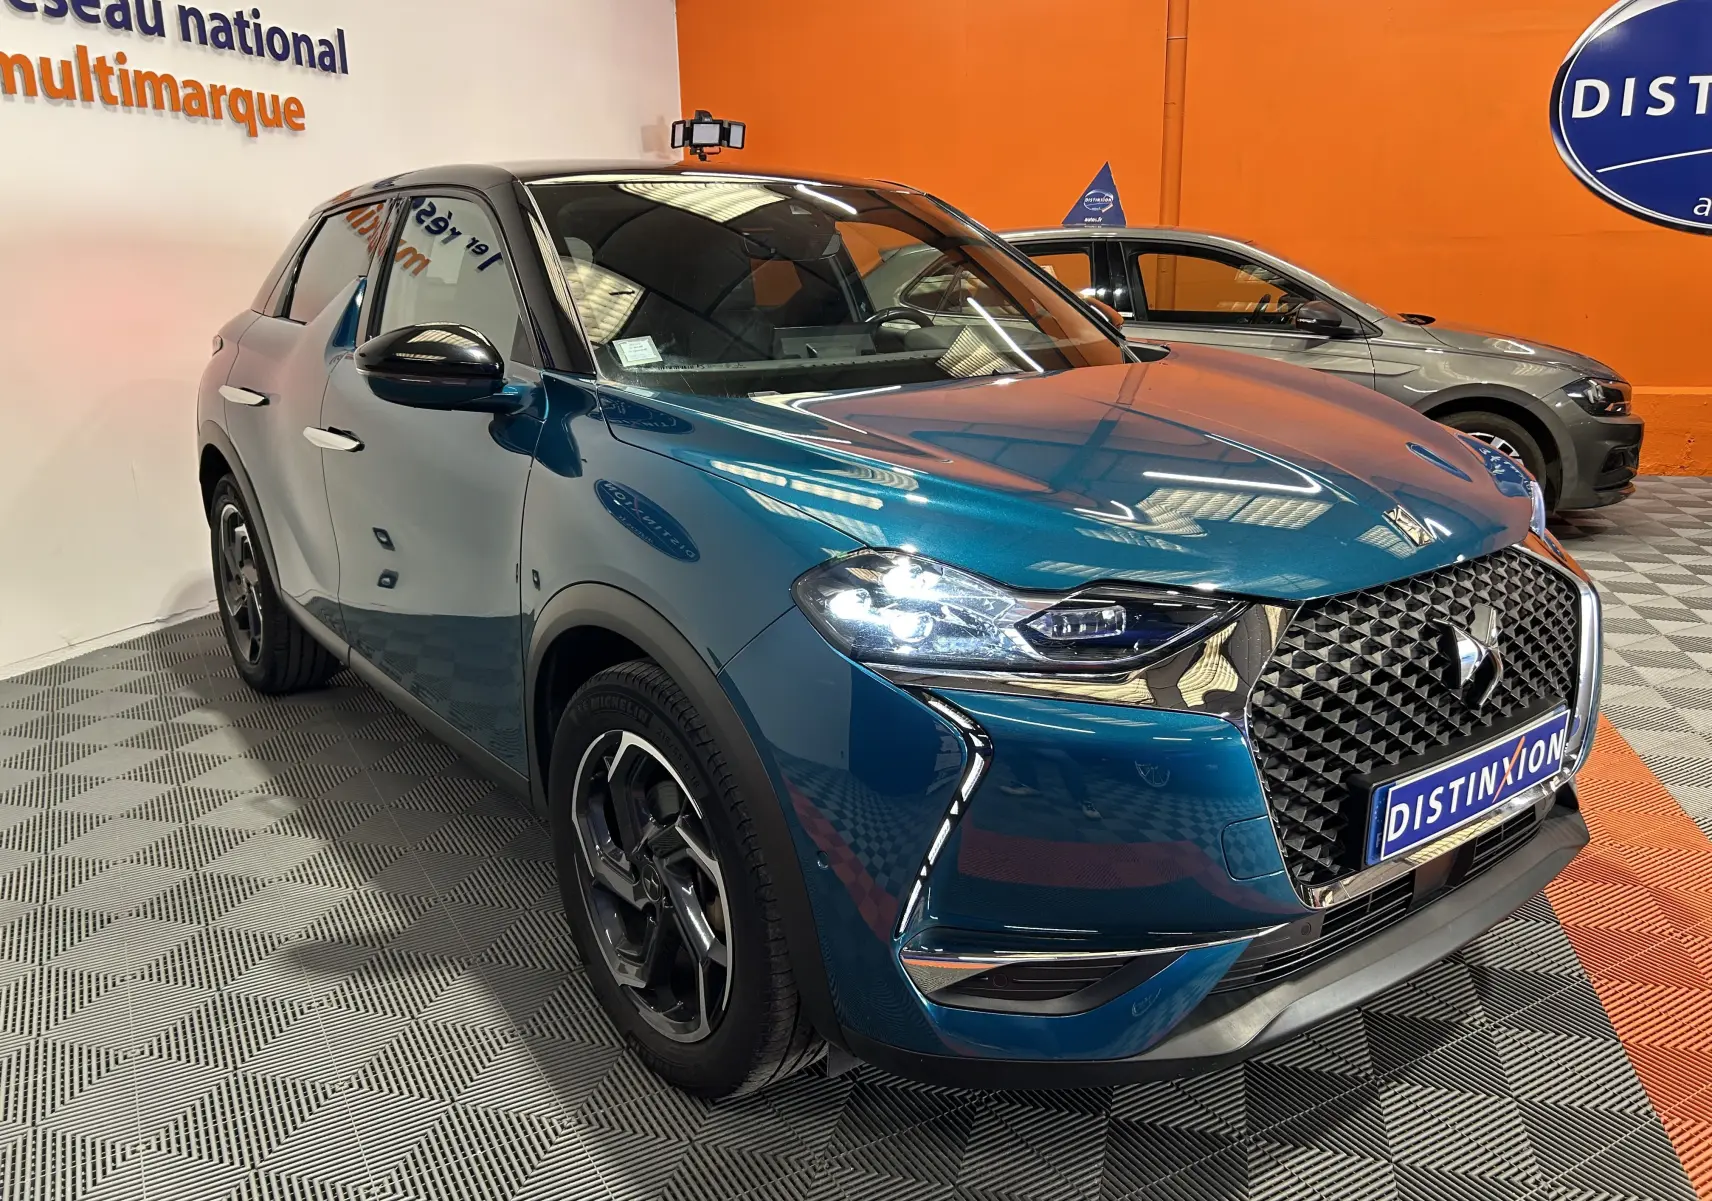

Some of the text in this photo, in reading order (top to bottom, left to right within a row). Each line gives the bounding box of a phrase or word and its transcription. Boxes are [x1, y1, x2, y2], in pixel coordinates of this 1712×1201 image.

[2, 0, 349, 75] seau national
[0, 44, 306, 137] multimarque
[1571, 75, 1712, 119] DIST
[591, 695, 650, 724] MICHELIN
[1387, 728, 1564, 843] DISTINXION
